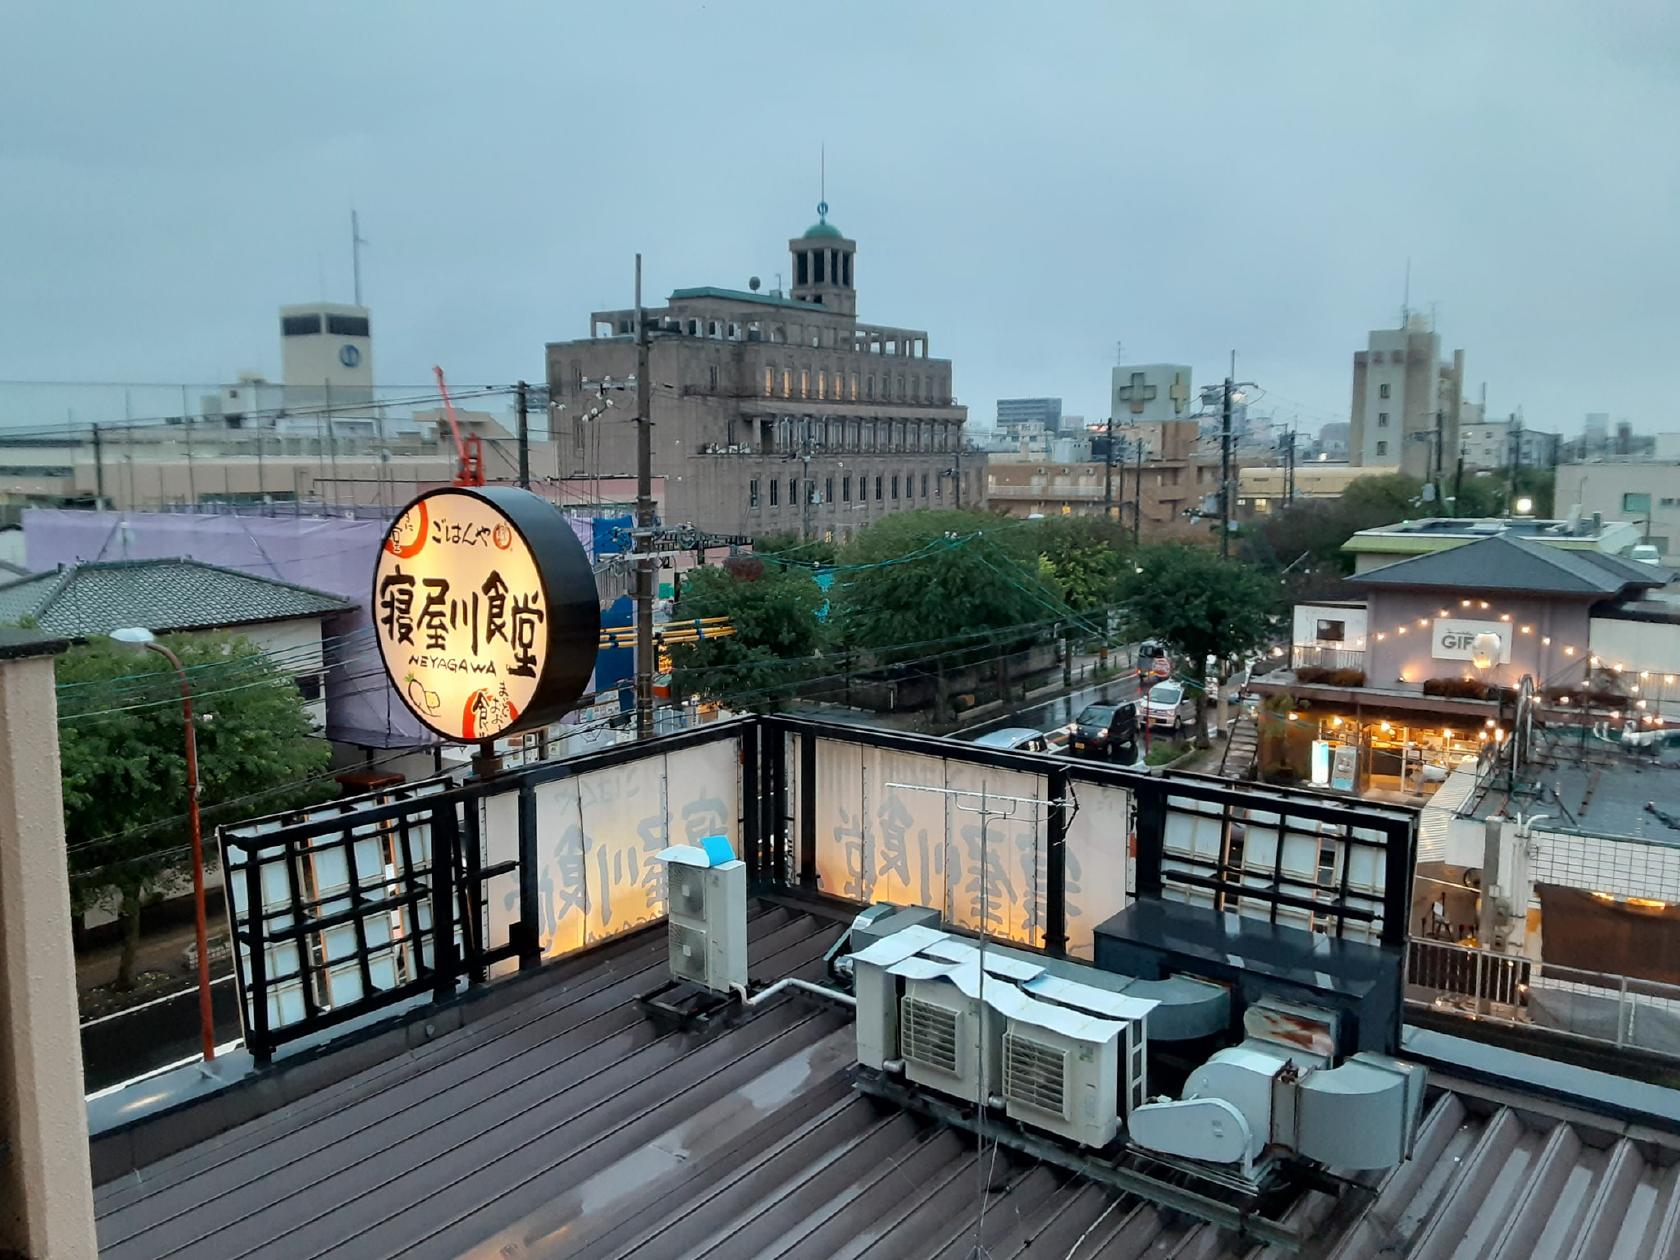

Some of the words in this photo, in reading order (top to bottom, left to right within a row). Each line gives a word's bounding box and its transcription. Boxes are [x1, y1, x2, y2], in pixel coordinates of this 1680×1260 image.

[432, 518, 491, 547] ごはんや
[380, 564, 545, 678] 寝屋川食堂
[408, 655, 497, 677] NEYAGAWA
